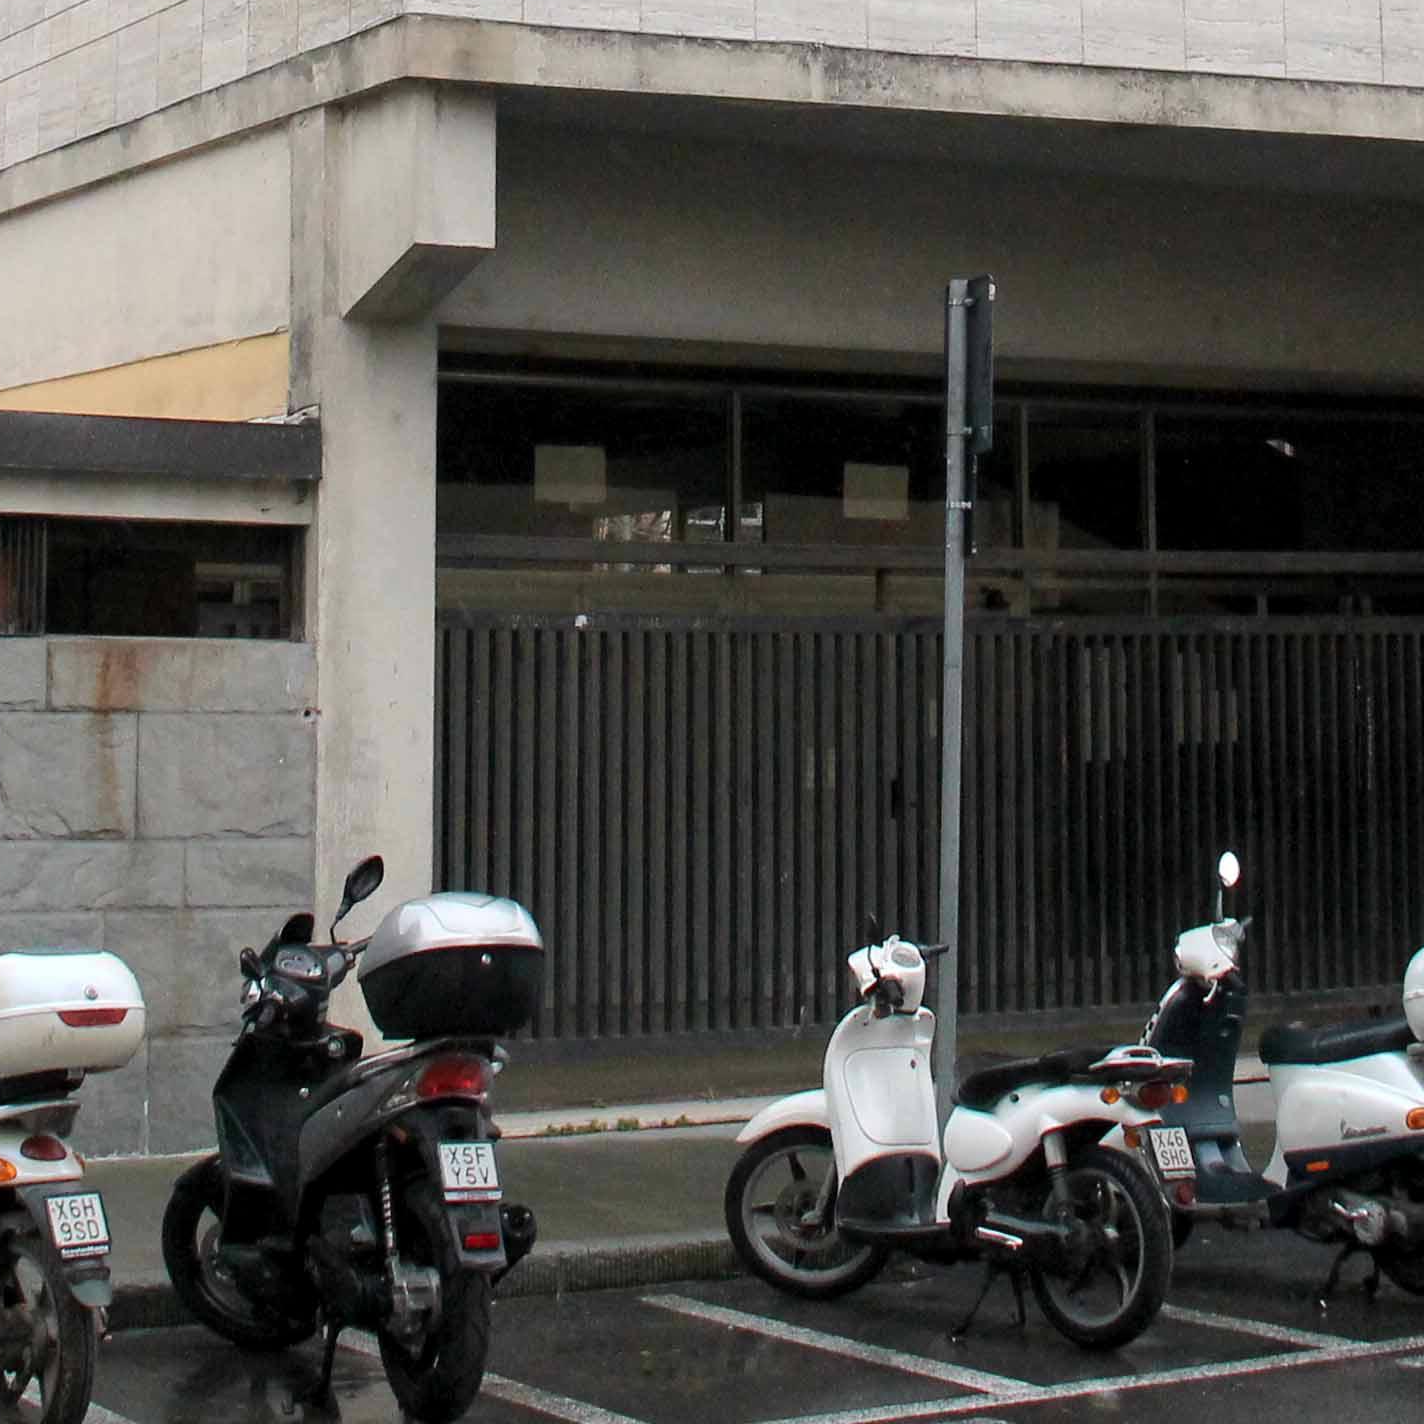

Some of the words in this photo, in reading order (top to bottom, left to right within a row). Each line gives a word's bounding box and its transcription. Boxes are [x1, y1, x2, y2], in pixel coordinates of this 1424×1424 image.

[448, 1146, 486, 1165] X5F
[451, 1167, 489, 1185] Y5V
[55, 1197, 96, 1221] X6H
[60, 1219, 100, 1242] 9SD
